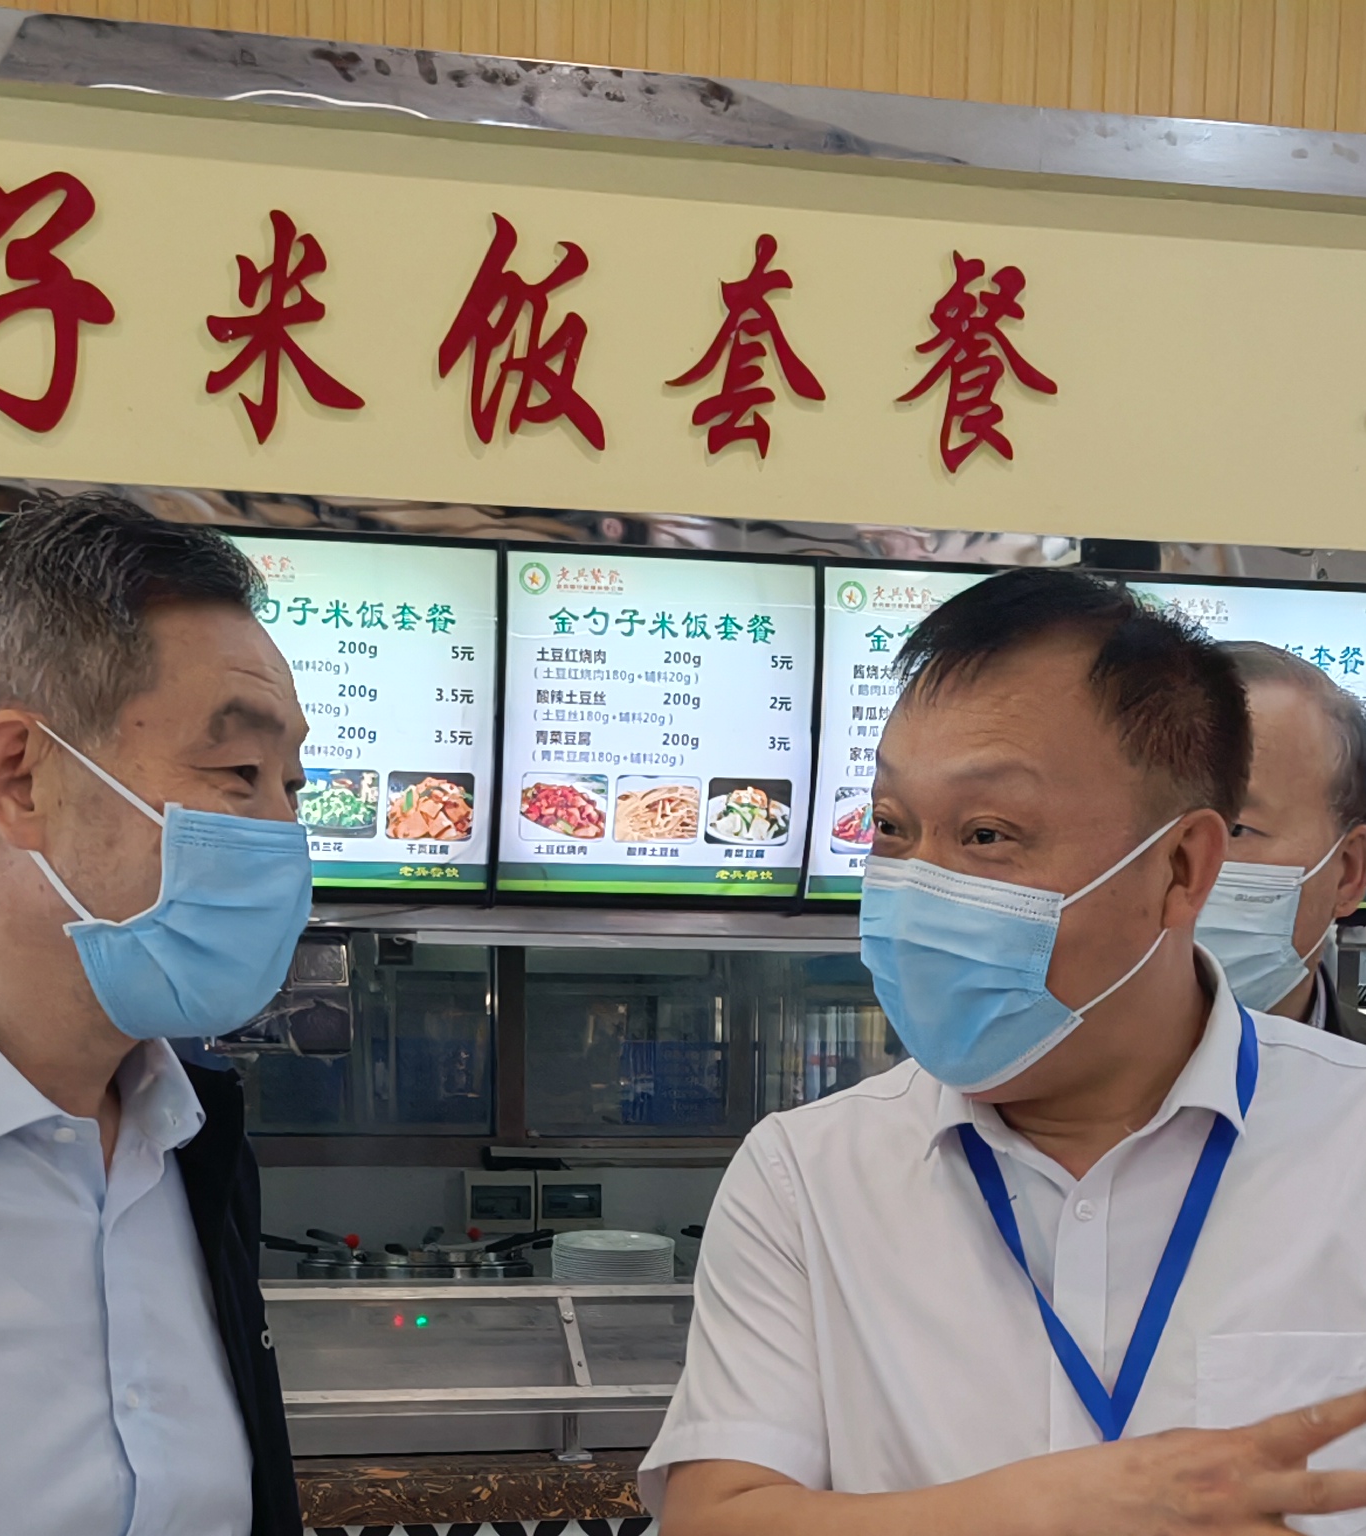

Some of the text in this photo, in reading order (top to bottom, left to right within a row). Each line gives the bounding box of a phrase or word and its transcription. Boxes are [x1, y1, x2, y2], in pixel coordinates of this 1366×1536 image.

[548, 606, 777, 645] 金勺子米饭套餐
[338, 640, 475, 662] 200g 5元
[536, 647, 794, 671] 土豆红烧肉 200g 5元
[338, 684, 475, 705] 200g 3.5元
[536, 689, 793, 712] 酸辣土豆丝 200g 2元
[337, 726, 474, 746] 200g 3.5元
[535, 730, 792, 752] 青菜豆腐 200g 3元
[310, 841, 344, 853] 西兰花
